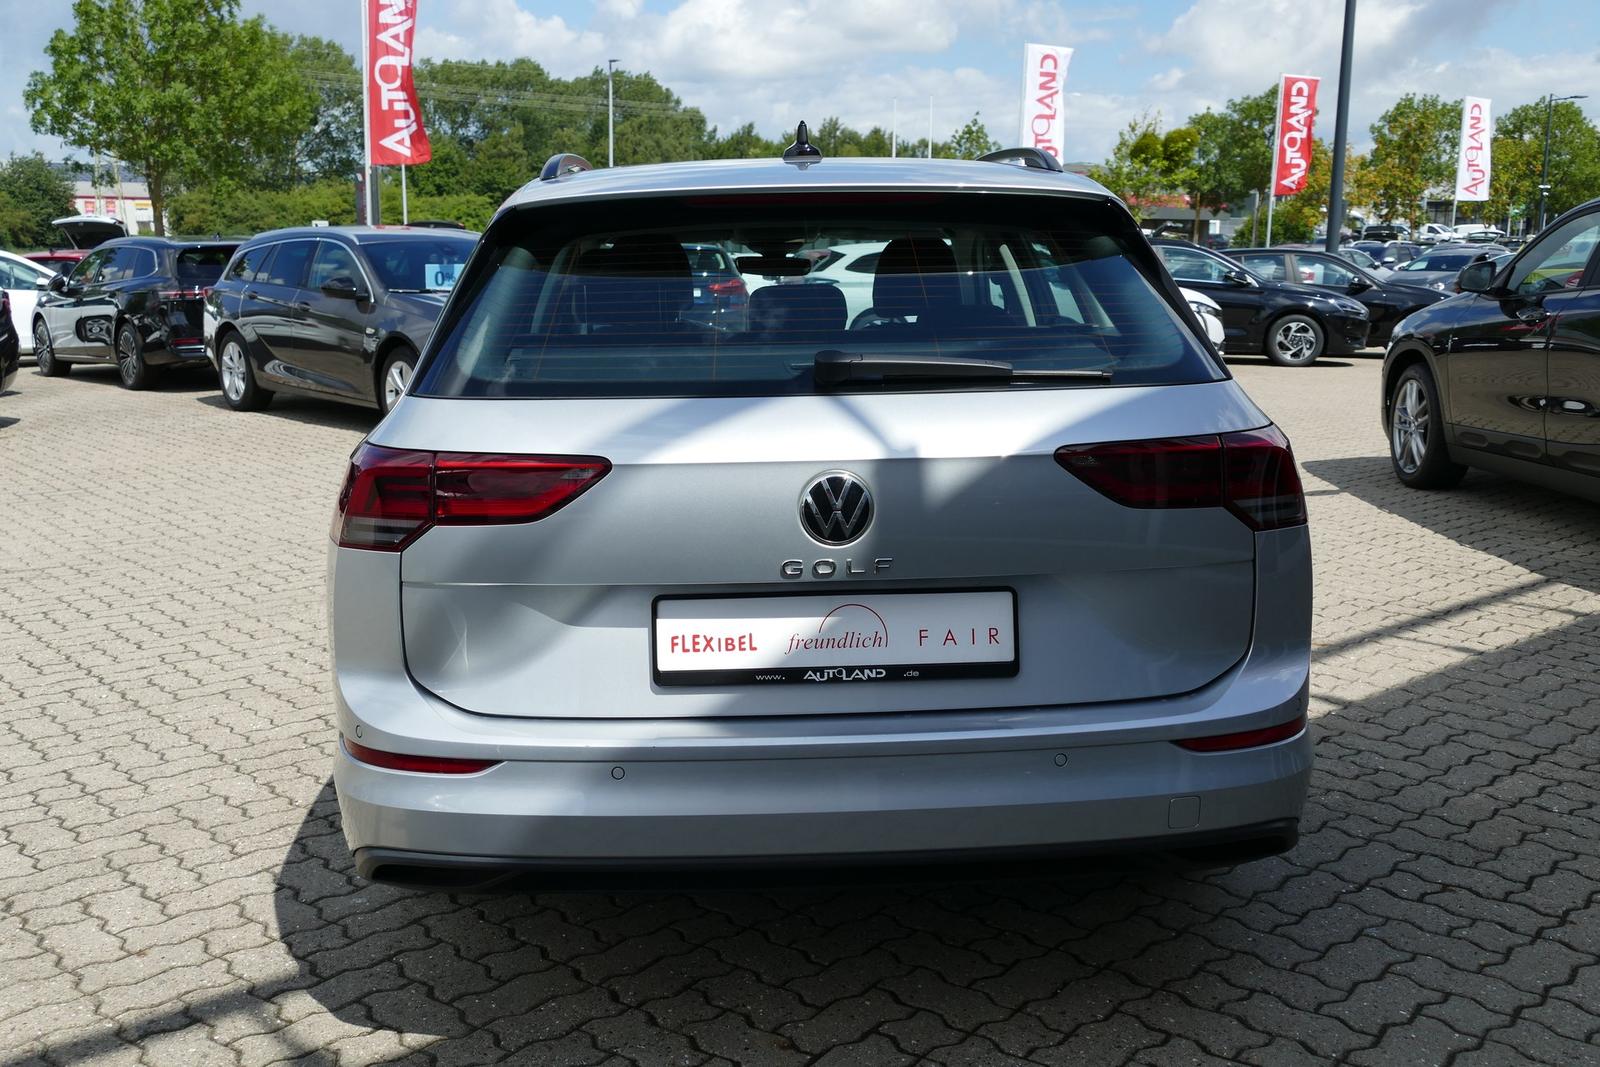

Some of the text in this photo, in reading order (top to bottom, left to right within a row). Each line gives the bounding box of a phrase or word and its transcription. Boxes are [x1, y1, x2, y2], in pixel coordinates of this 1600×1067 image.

[375, 0, 418, 158] AUTOLAN
[1031, 53, 1060, 158] UTOLAND
[1280, 81, 1312, 189] AUTOLAND
[1462, 103, 1486, 196] AUTOLAND
[803, 475, 871, 541] VW
[780, 557, 893, 579] GOLF
[670, 627, 1000, 655] FLEXIBEL freundlich FAIR
[803, 667, 887, 682] AUTOLAND
